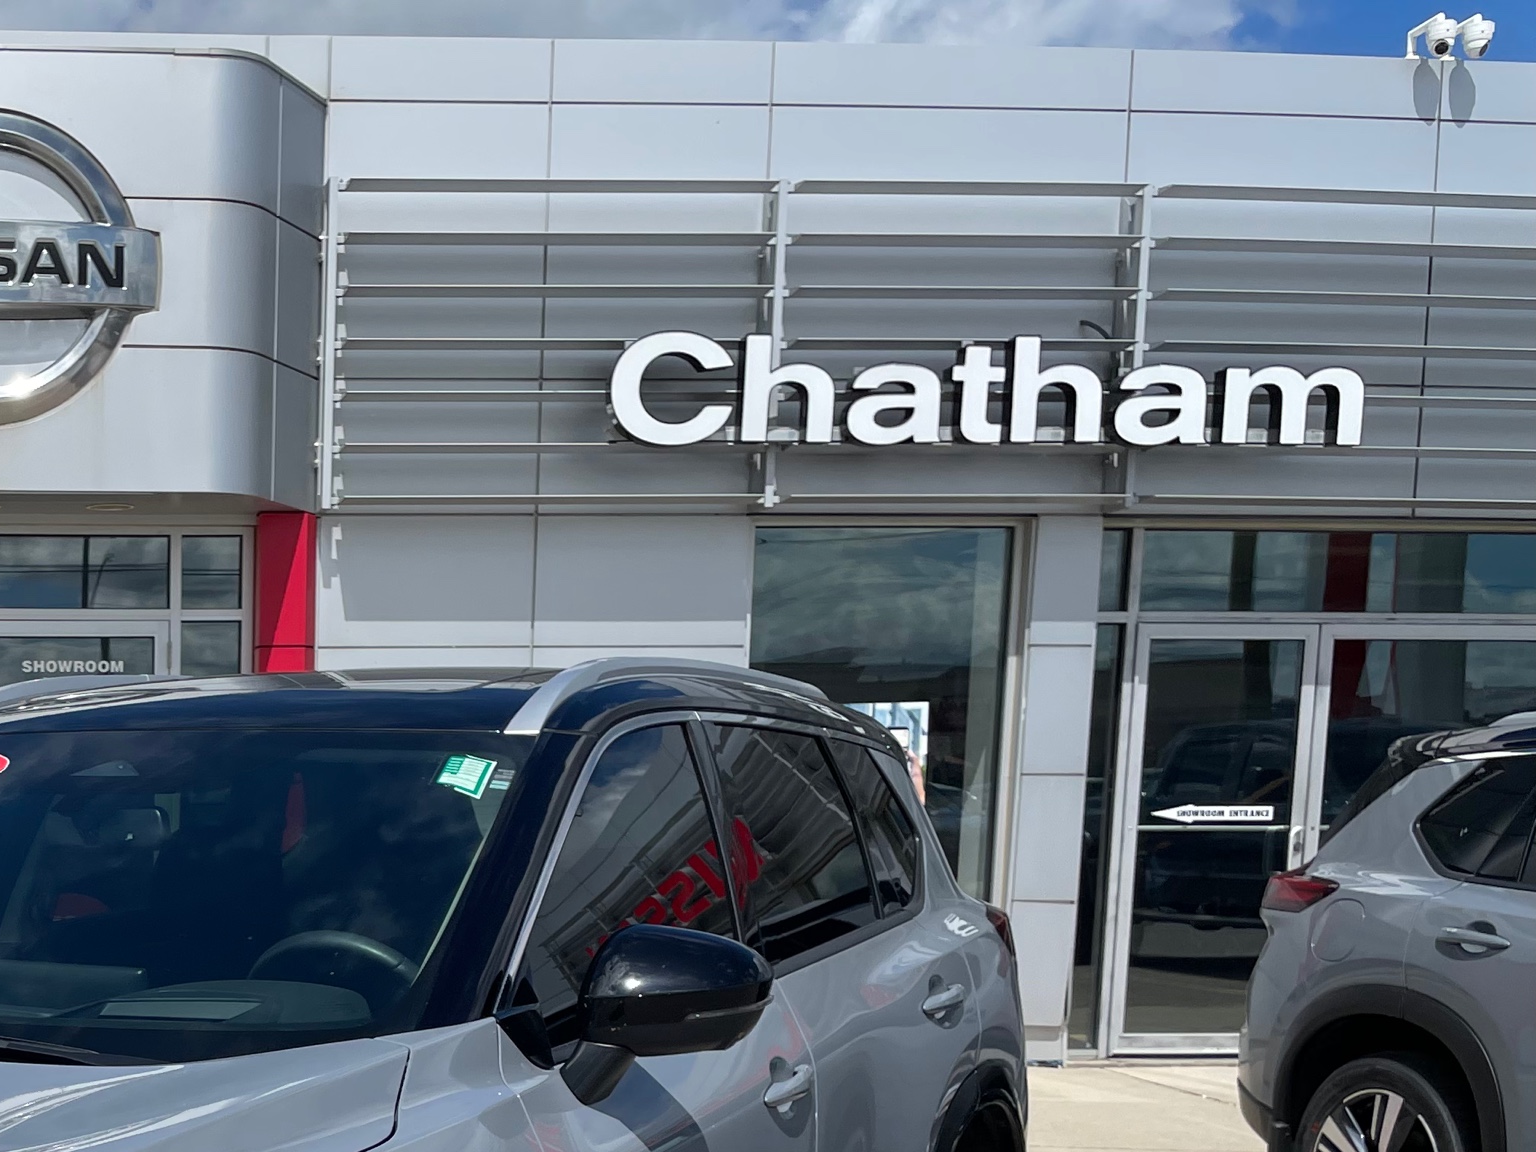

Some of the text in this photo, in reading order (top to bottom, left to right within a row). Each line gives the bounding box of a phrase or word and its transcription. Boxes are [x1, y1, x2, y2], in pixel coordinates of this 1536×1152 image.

[609, 330, 1365, 446] Chatham
[21, 660, 124, 673] SHOWROOM
[1176, 809, 1270, 818] SHOWROOM ENTRANCE
